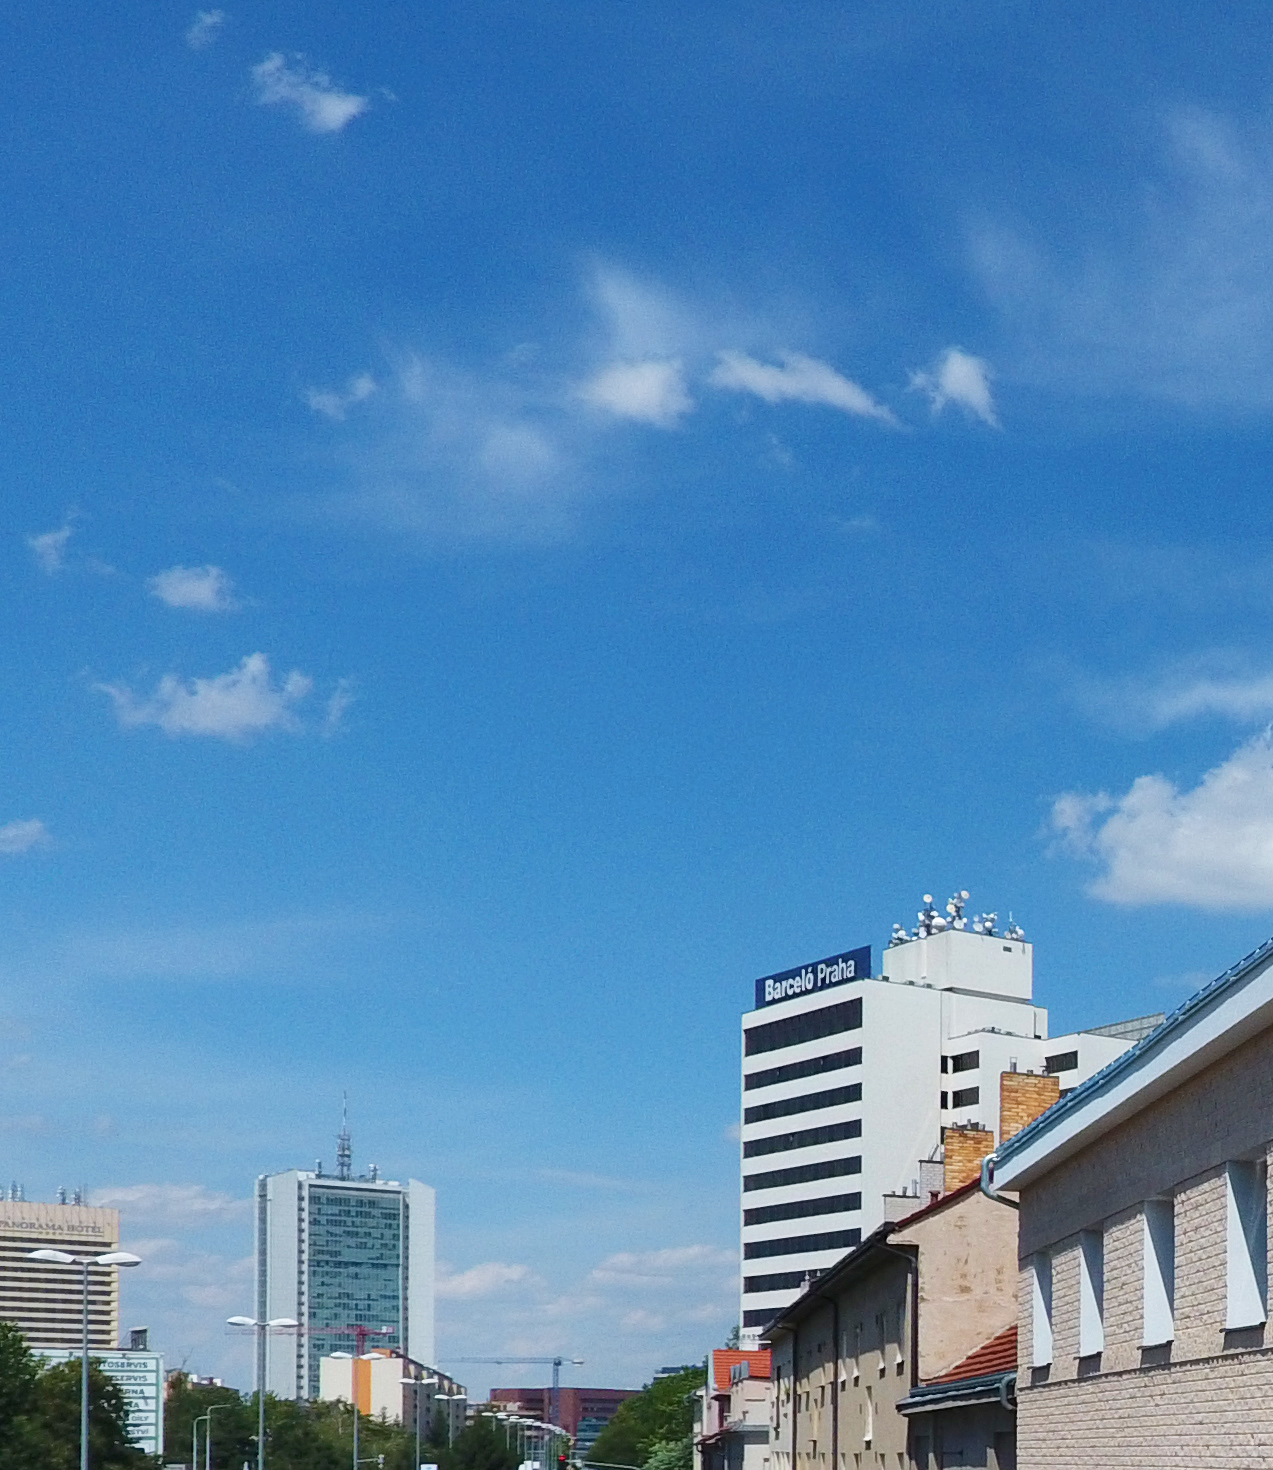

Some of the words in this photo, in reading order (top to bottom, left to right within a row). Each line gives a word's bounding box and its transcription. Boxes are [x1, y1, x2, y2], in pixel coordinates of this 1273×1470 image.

[765, 967, 814, 1002] Barceló
[817, 957, 855, 987] Praha
[67, 1224, 104, 1234] HOTEL
